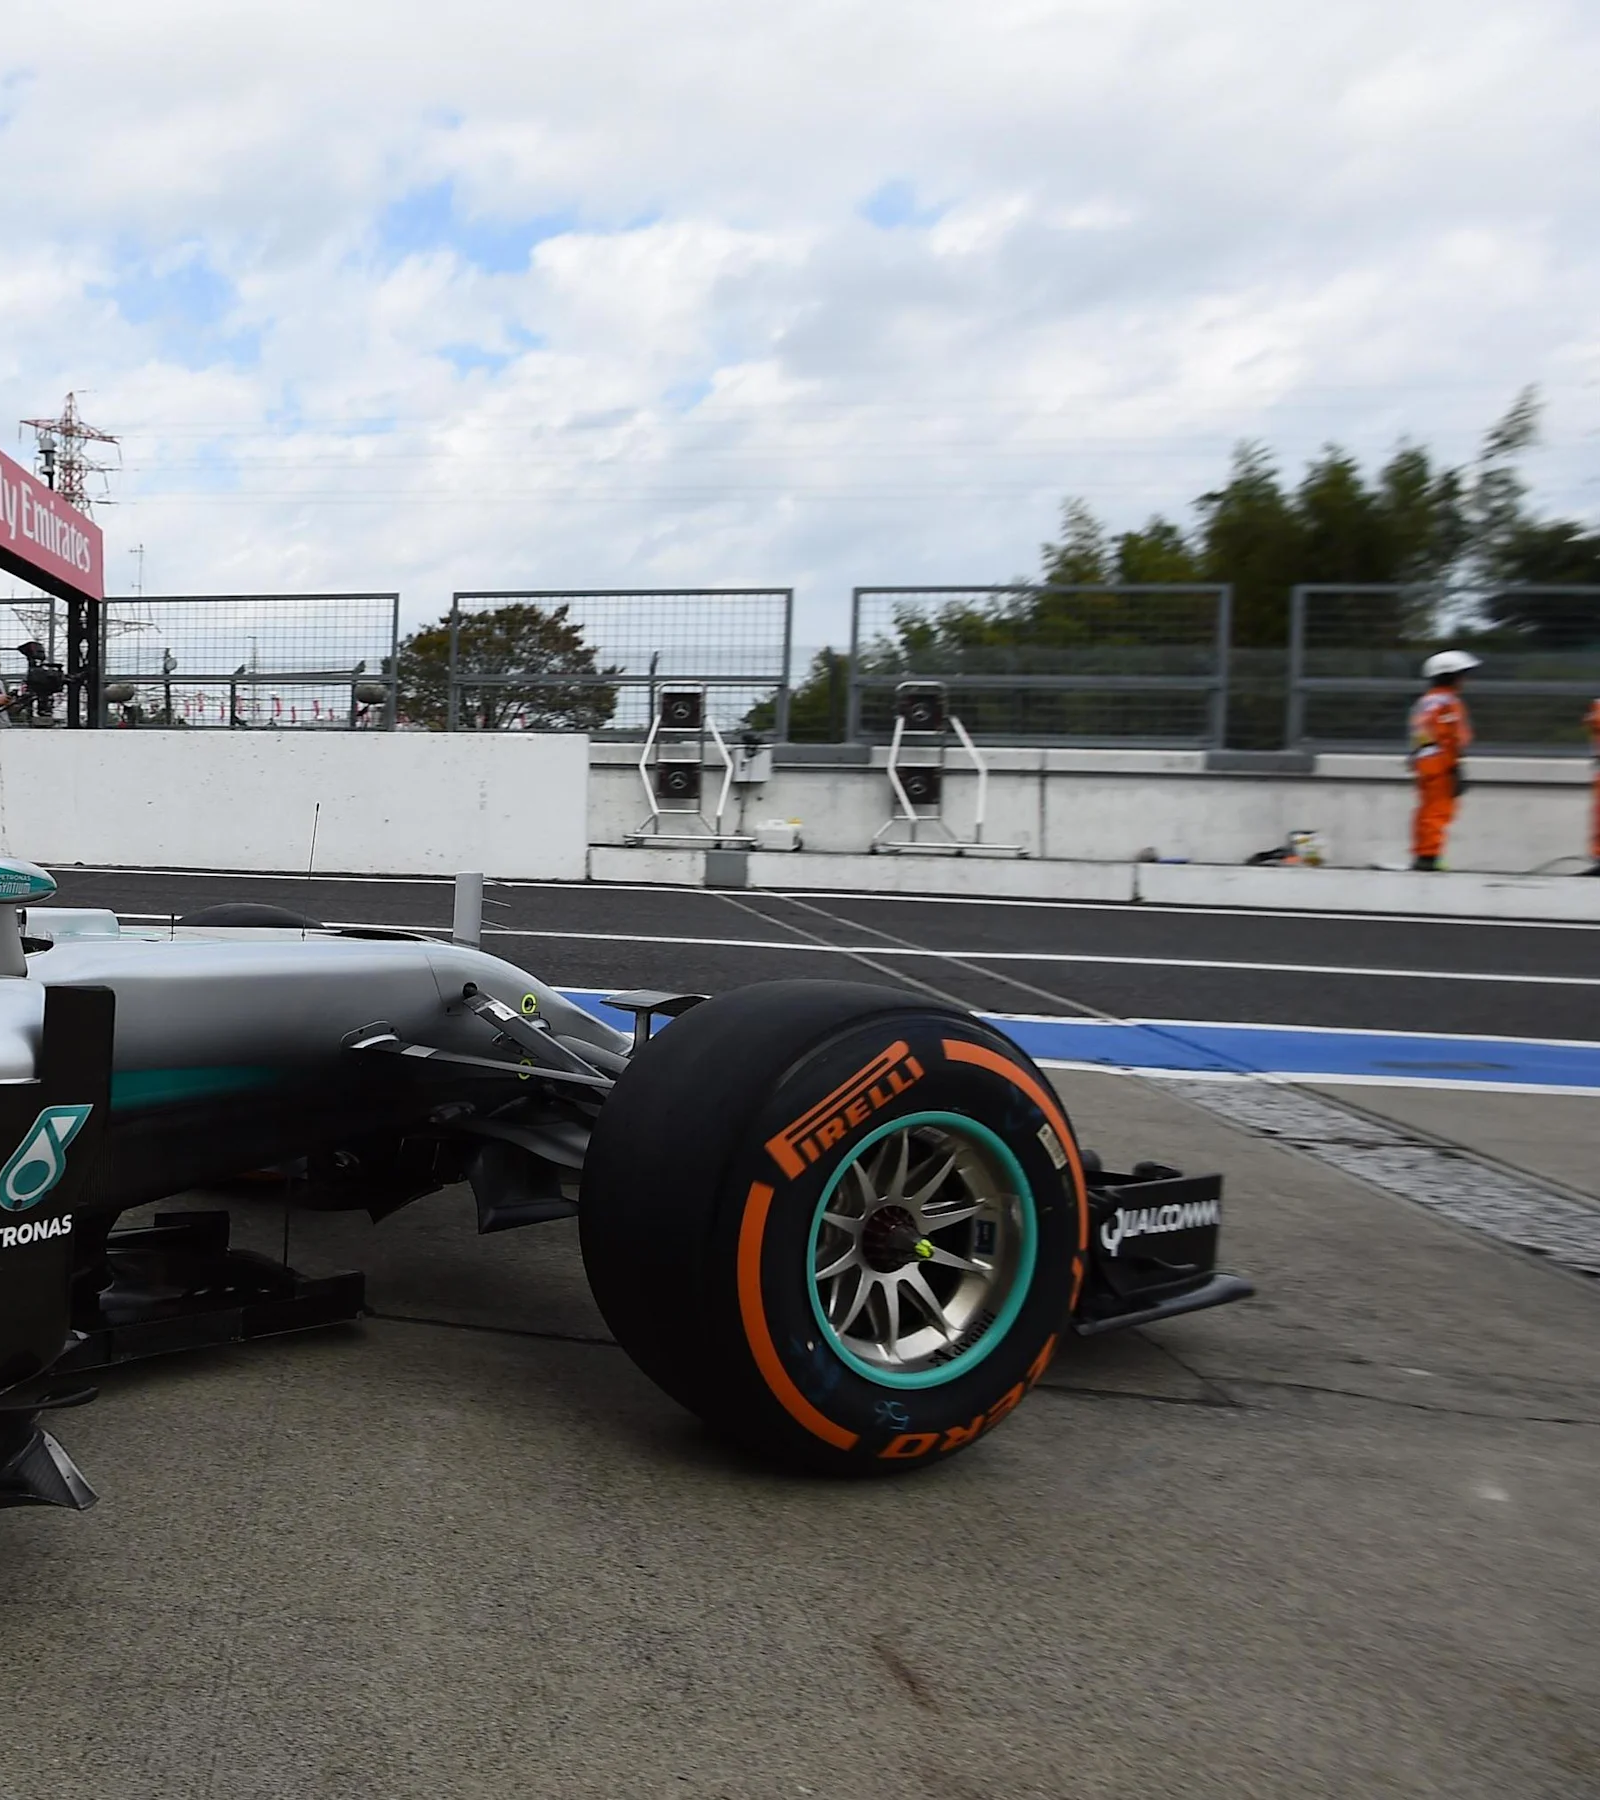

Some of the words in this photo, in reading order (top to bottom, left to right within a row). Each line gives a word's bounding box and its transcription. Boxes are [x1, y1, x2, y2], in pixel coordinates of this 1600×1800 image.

[20, 480, 91, 573] Emirates
[764, 1040, 925, 1181] PIRELLI
[1101, 1199, 1221, 1257] QUALCOMM
